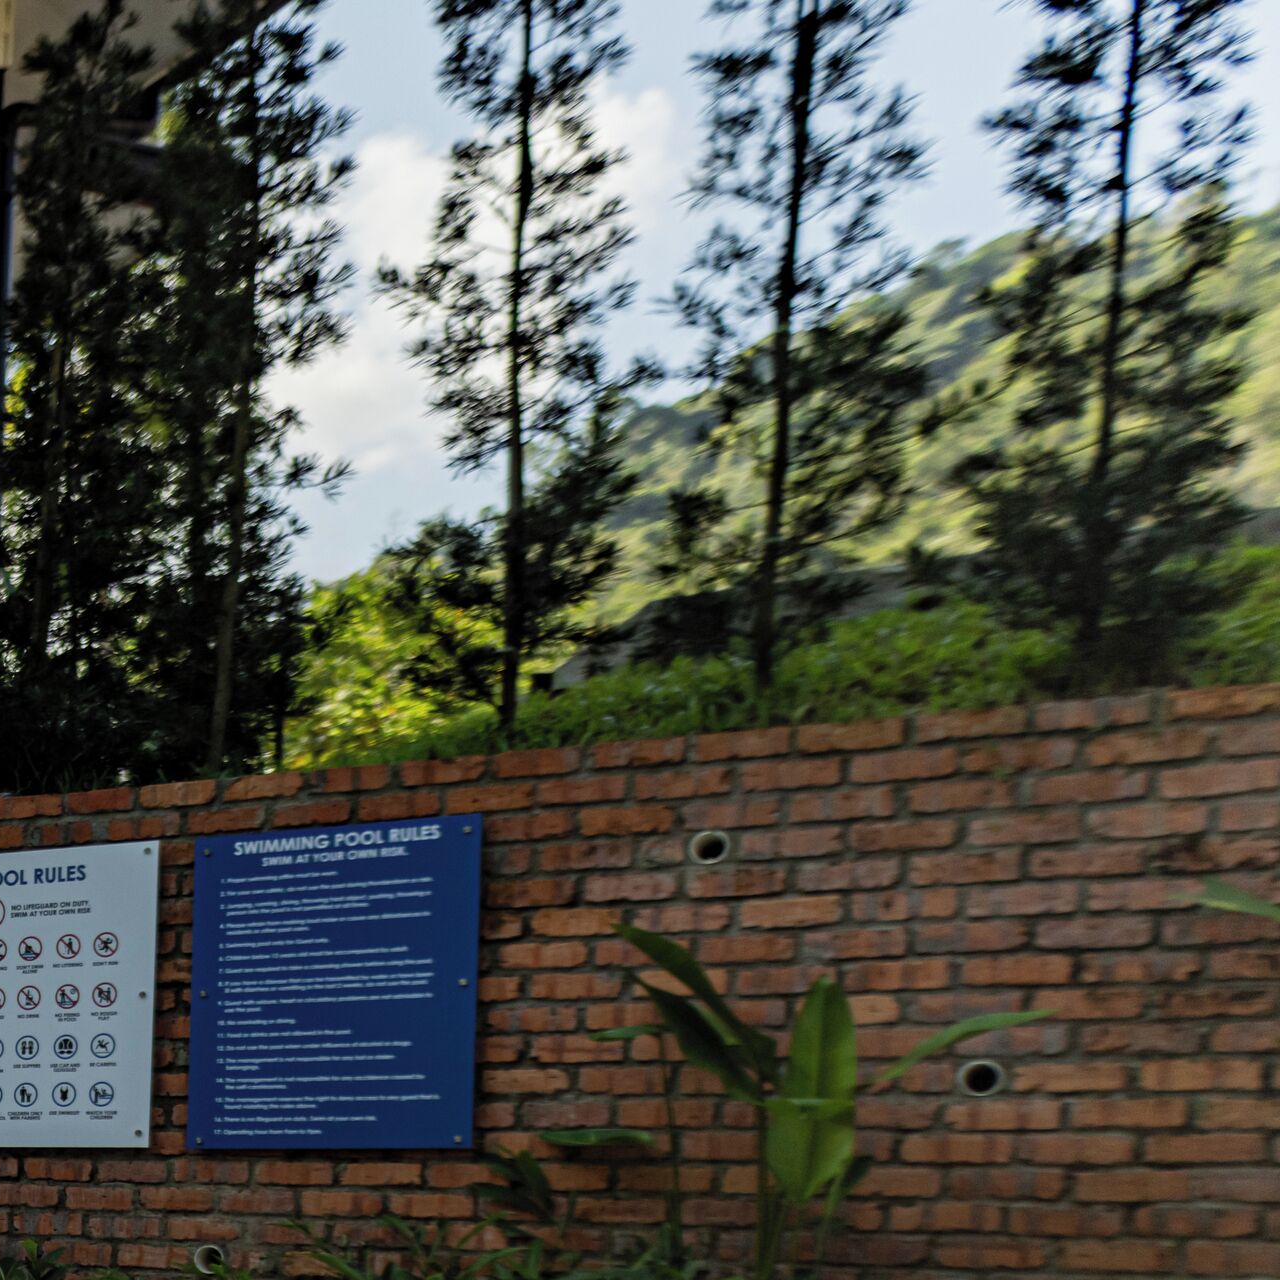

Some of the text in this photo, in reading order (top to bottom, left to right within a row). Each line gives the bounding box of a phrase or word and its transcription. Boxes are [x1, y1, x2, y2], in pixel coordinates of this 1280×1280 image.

[234, 824, 441, 856] SWIMMING POOL RULES
[262, 856, 292, 867] SWIM
[296, 854, 309, 864] AT
[313, 851, 344, 862] YOUR
[347, 849, 377, 860] OWN
[33, 864, 86, 884] RULES
[23, 902, 58, 910] LIFEGUARD
